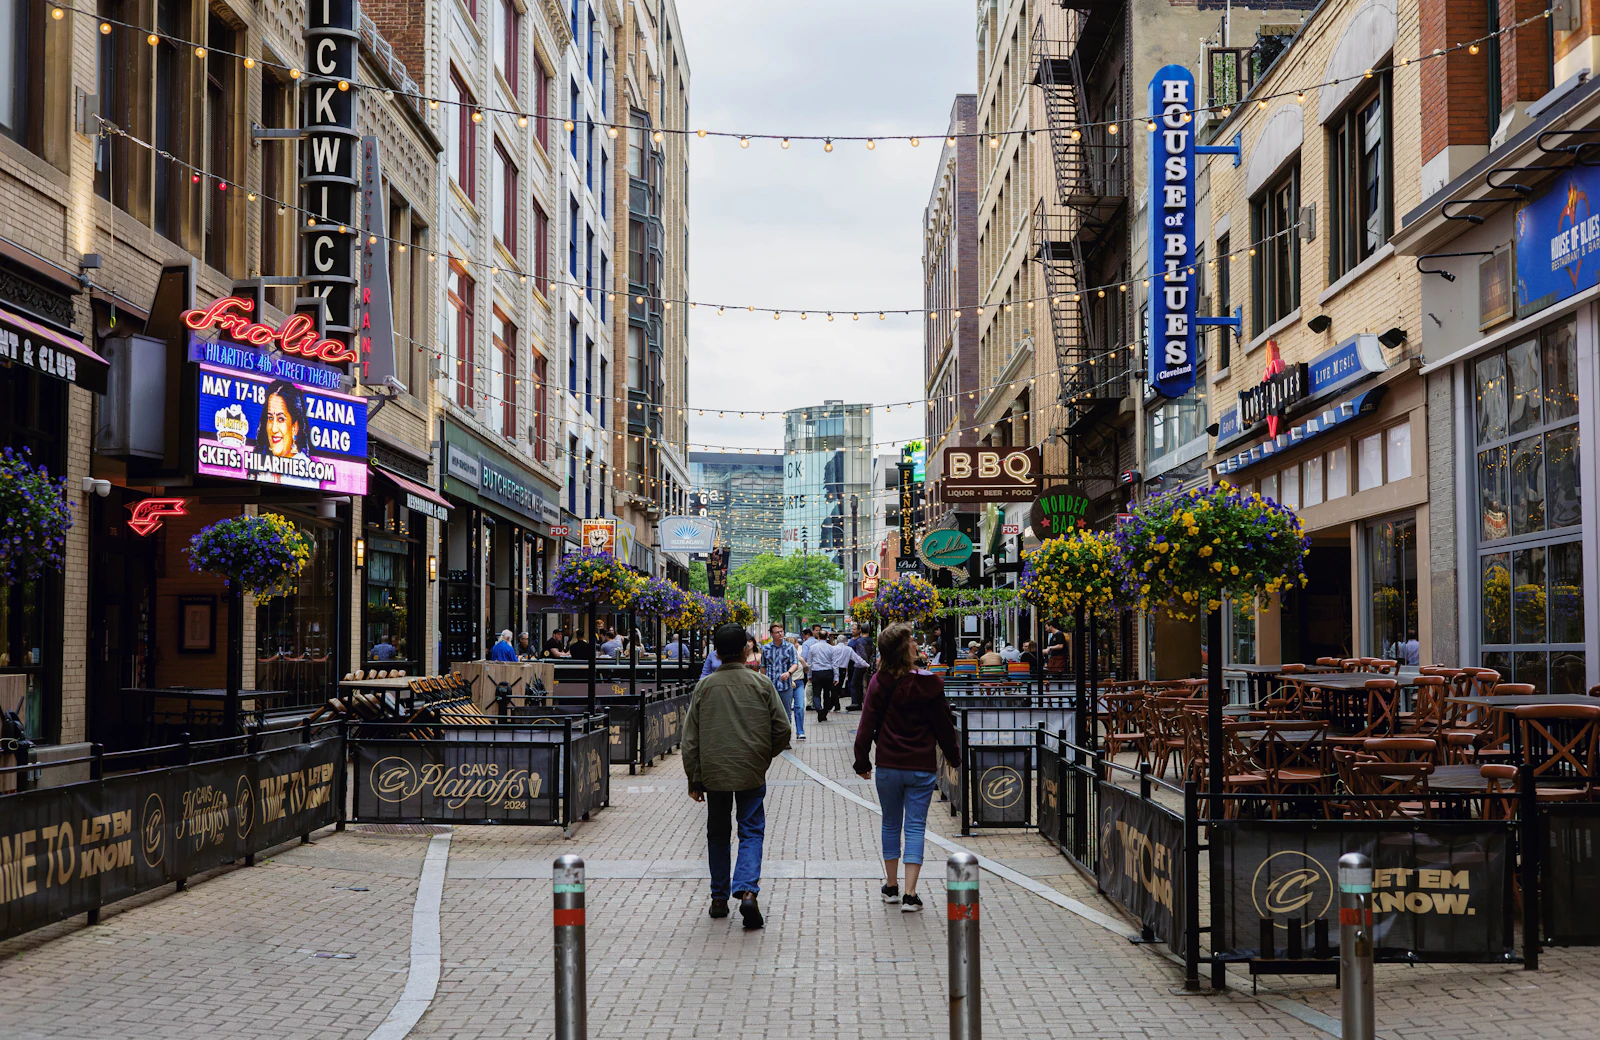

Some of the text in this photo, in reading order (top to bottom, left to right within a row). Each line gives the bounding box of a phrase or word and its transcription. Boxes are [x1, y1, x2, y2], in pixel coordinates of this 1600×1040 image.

[1161, 80, 1189, 365] HOUSE of BLUES
[1551, 230, 1570, 261] HOUSE
[1580, 214, 1600, 245] BLUES
[362, 141, 374, 378] RESTAURANT
[180, 296, 357, 363] Frolic
[23, 339, 34, 367] &
[39, 345, 76, 382] CLUB
[206, 342, 341, 389] HILARITIES 4th STREET THEATRE
[1315, 353, 1355, 385] LIVE MUSIC
[202, 375, 266, 405] MAY 17-18
[1271, 371, 1301, 409] BLUES
[306, 397, 356, 426] ZARNA
[310, 426, 351, 452] GARG
[244, 450, 335, 481] HILARITIES.COM
[483, 465, 516, 500] BUTCHER
[949, 451, 1035, 485] BBQ
[947, 489, 975, 497] LIQUOR
[1039, 494, 1089, 516] WONDER
[1052, 515, 1075, 534] BAR
[897, 560, 917, 569] Pub
[308, 766, 322, 787] LET
[403, 763, 528, 809] Playoffs
[459, 763, 499, 776] CAVS
[196, 785, 213, 805] CAVS
[260, 769, 306, 825] TIME TO
[490, 800, 526, 810] 2024
[80, 809, 132, 845] LET EM
[176, 790, 223, 852] Playoffs
[0, 821, 75, 904] ME TO
[80, 839, 134, 879] KNOW.
[1371, 868, 1470, 889] ET EM
